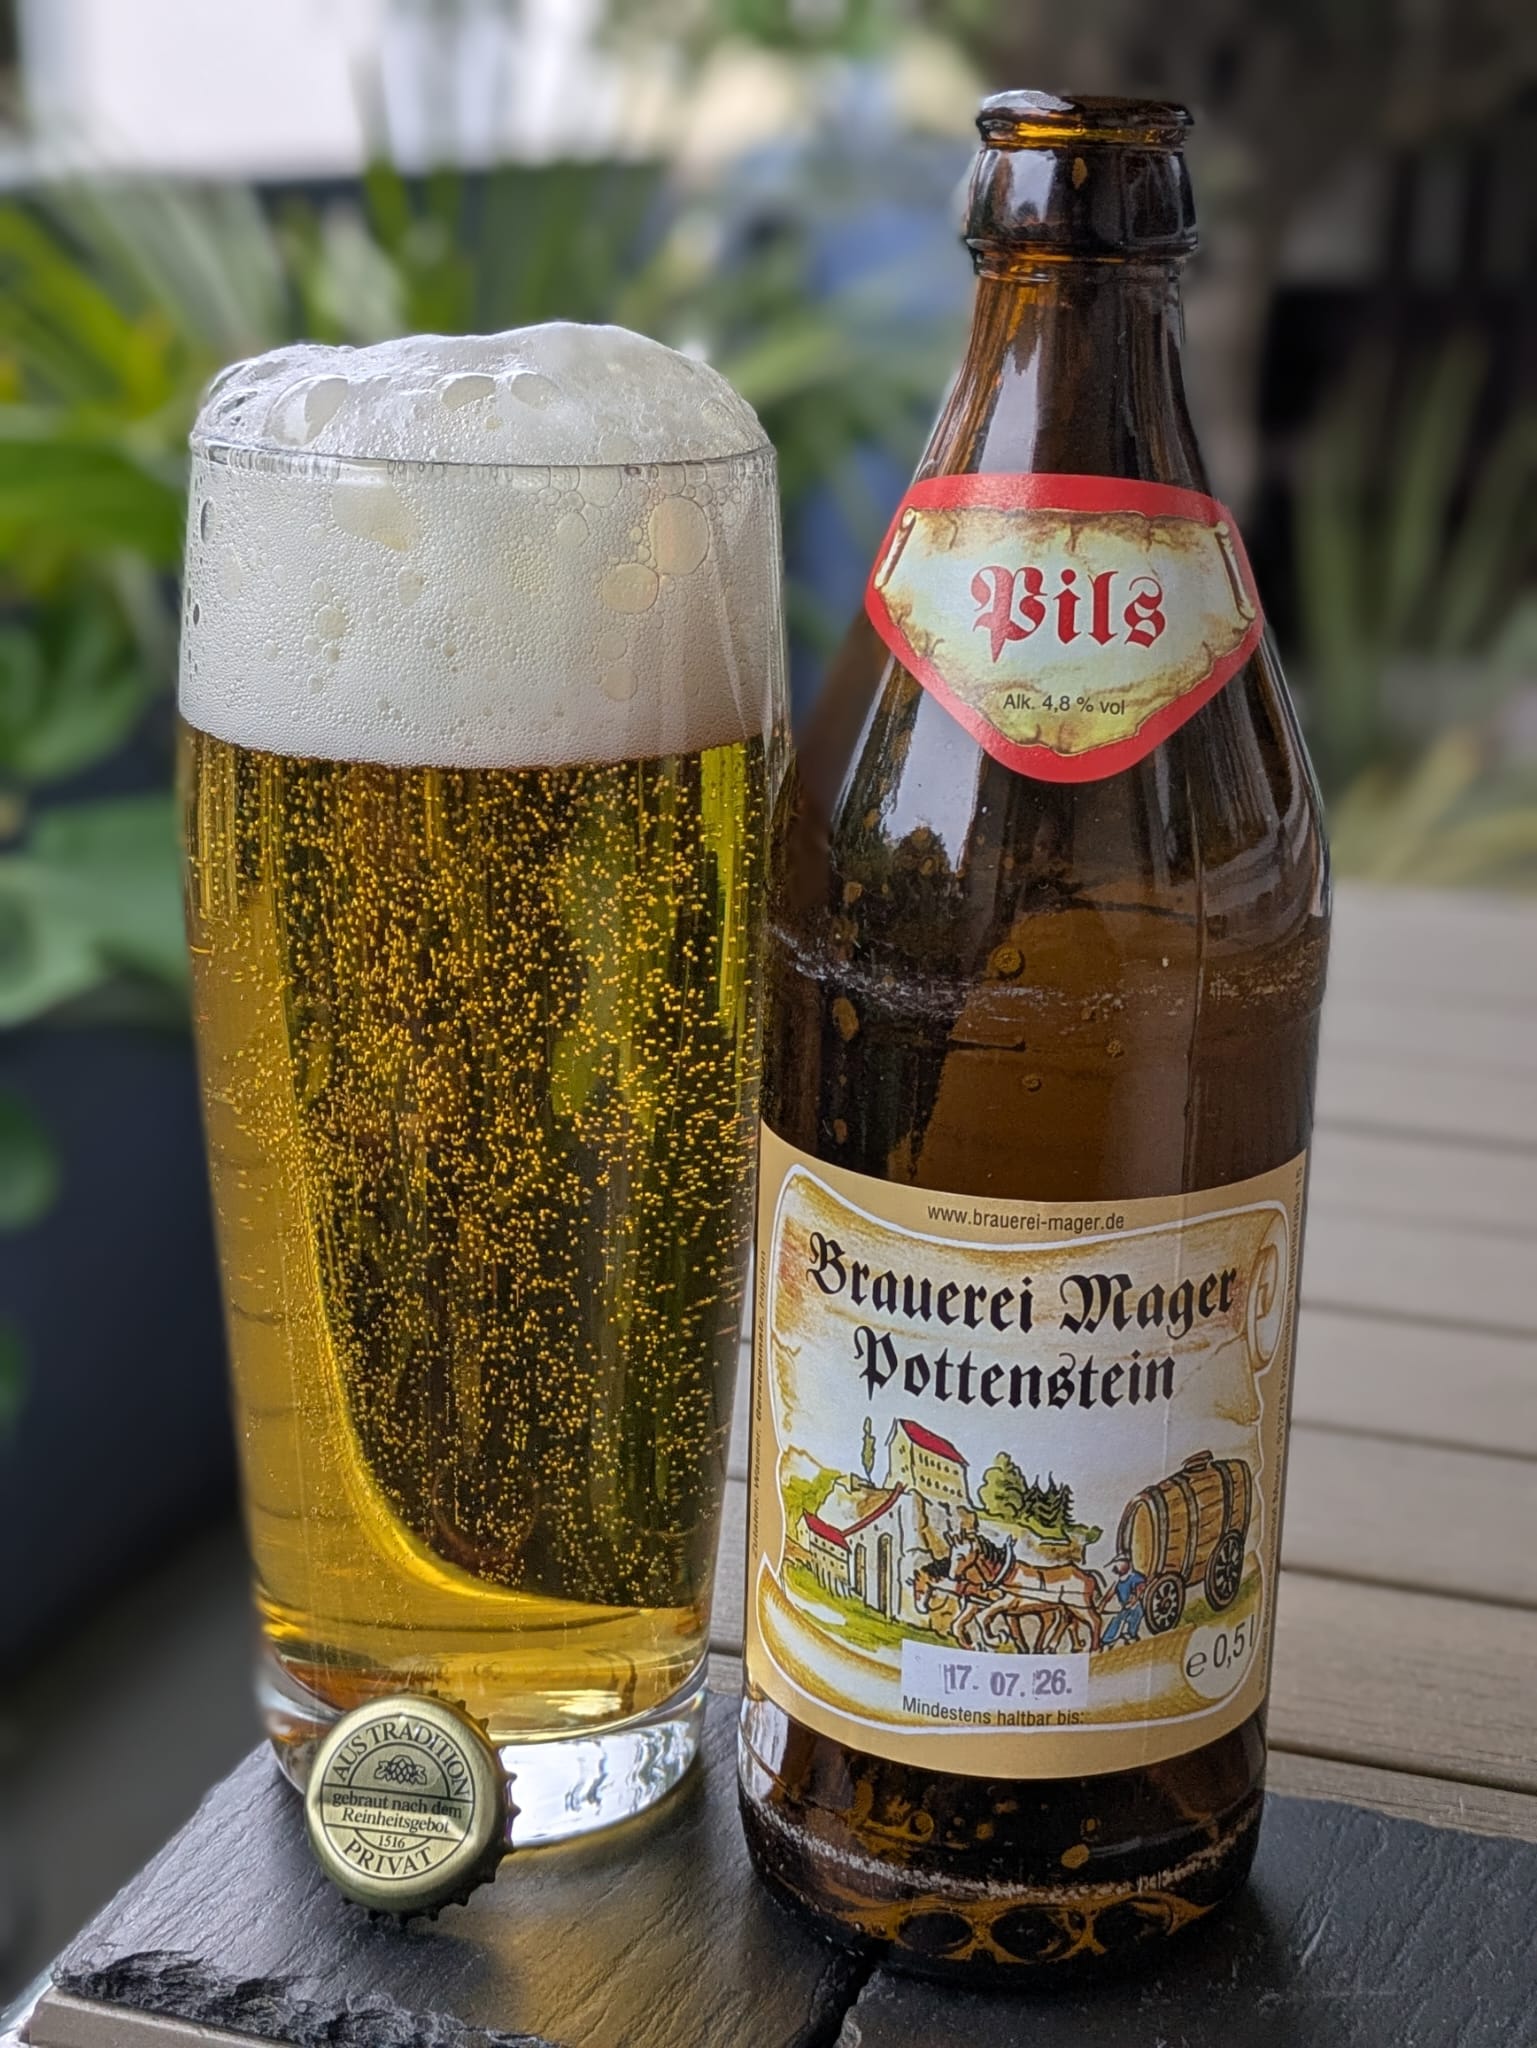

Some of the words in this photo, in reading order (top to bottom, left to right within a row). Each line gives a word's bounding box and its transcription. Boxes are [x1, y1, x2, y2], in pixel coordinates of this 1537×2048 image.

[970, 565, 1167, 664] Pils
[1003, 693, 1035, 710] Alk.
[1042, 695, 1071, 714] 4,8
[1076, 695, 1094, 714] %
[1099, 698, 1125, 716] vol
[927, 1203, 1125, 1235] www.brauerei-mager.de
[806, 1232, 1034, 1333] Brauerei
[1058, 1264, 1239, 1341] Mager
[853, 1325, 1176, 1410] Pottenstein
[1212, 1622, 1246, 1670] 0,5
[945, 1664, 979, 1694] 17.
[990, 1671, 1026, 1697] 07.
[1036, 1669, 1072, 1697] 26.
[902, 1695, 991, 1725] Mindestens
[997, 1710, 1050, 1728] haltbar
[1055, 1710, 1085, 1727] bis:
[332, 1735, 369, 1782] AUS
[364, 1720, 470, 1797] TRADITION
[332, 1790, 388, 1811] gebraut
[392, 1796, 427, 1815] nach
[431, 1801, 462, 1819] dem
[341, 1806, 450, 1834] Reinheitsgebot
[343, 1838, 431, 1876] PRIVAT
[378, 1834, 406, 1849] 1516
